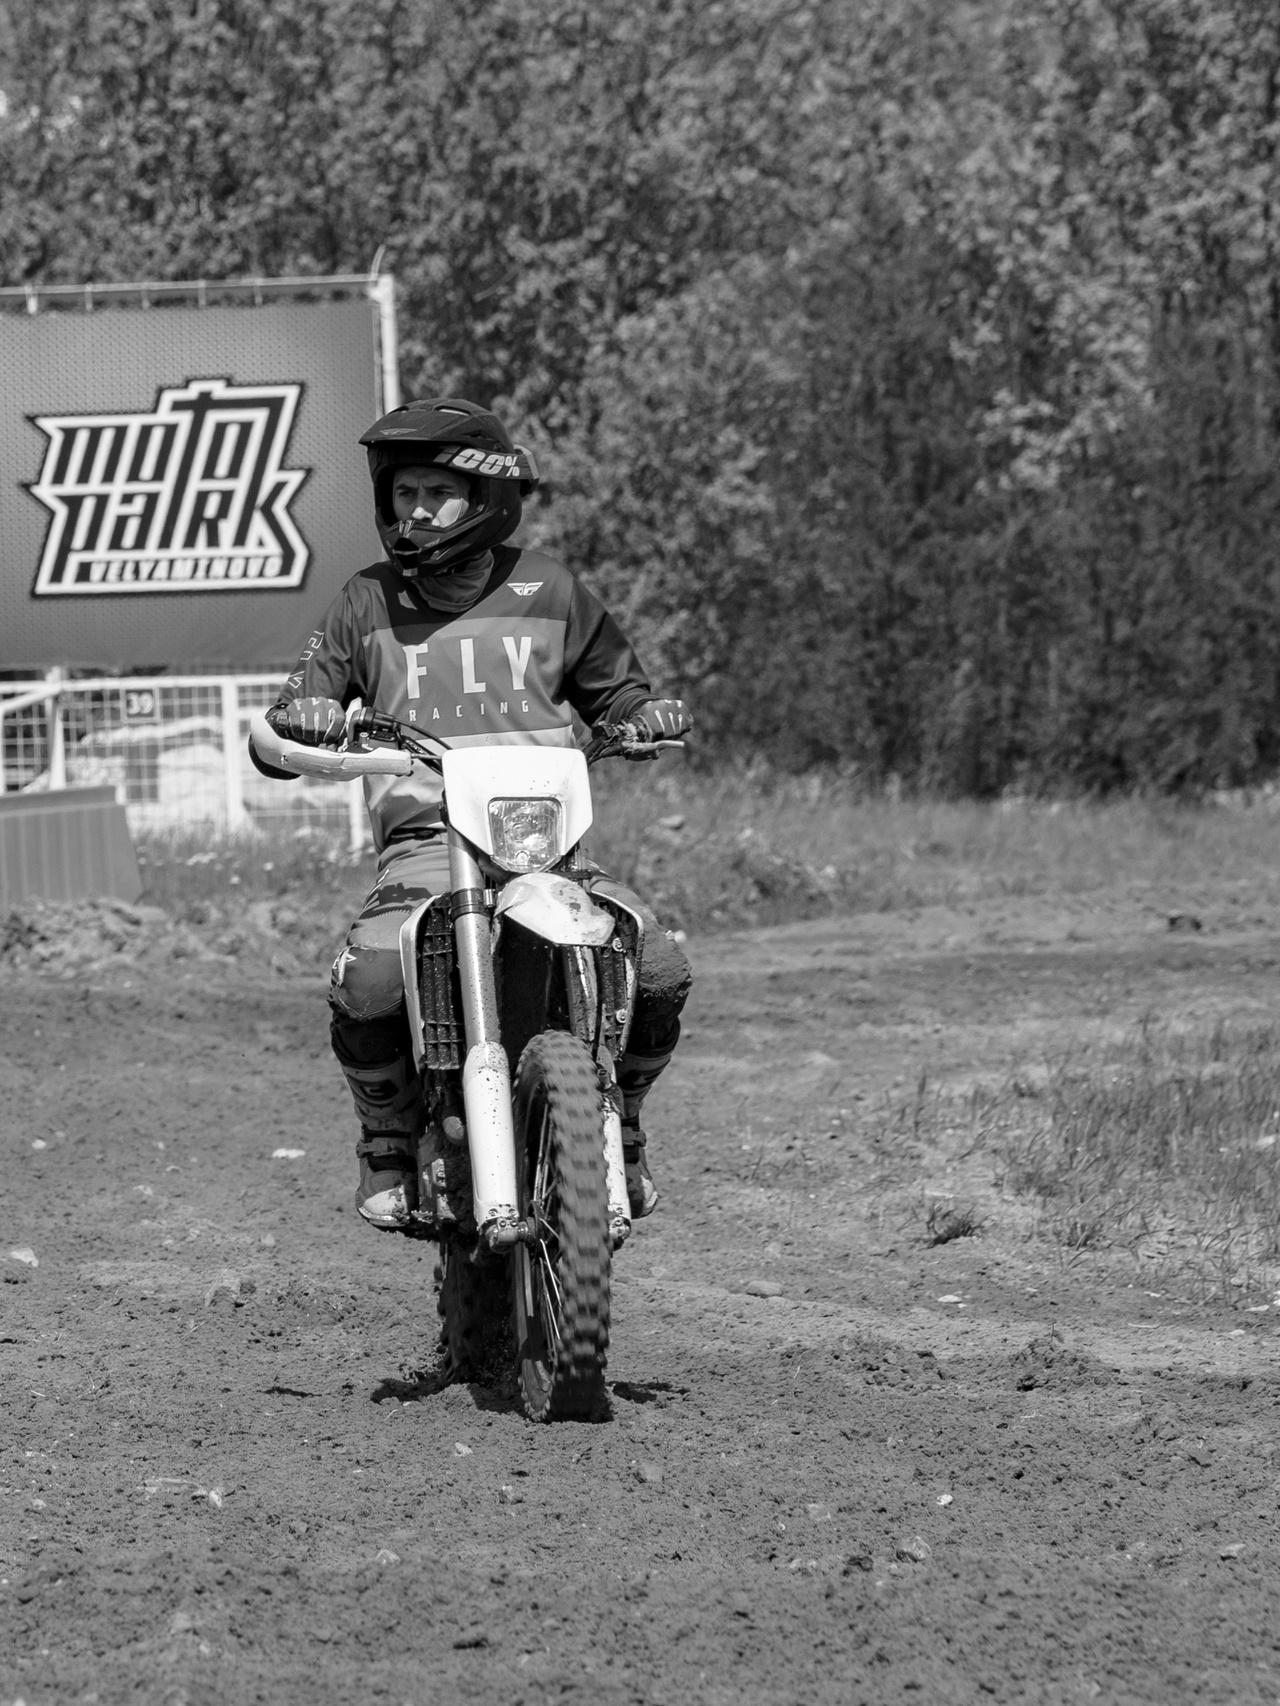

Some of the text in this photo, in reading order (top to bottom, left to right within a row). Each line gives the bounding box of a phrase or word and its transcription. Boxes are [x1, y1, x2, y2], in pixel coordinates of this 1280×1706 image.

[433, 446, 520, 477] 100%
[89, 556, 283, 583] VELYAMINOVO
[402, 636, 533, 699] FLY
[126, 692, 154, 715] 39
[408, 700, 529, 722] RACING
